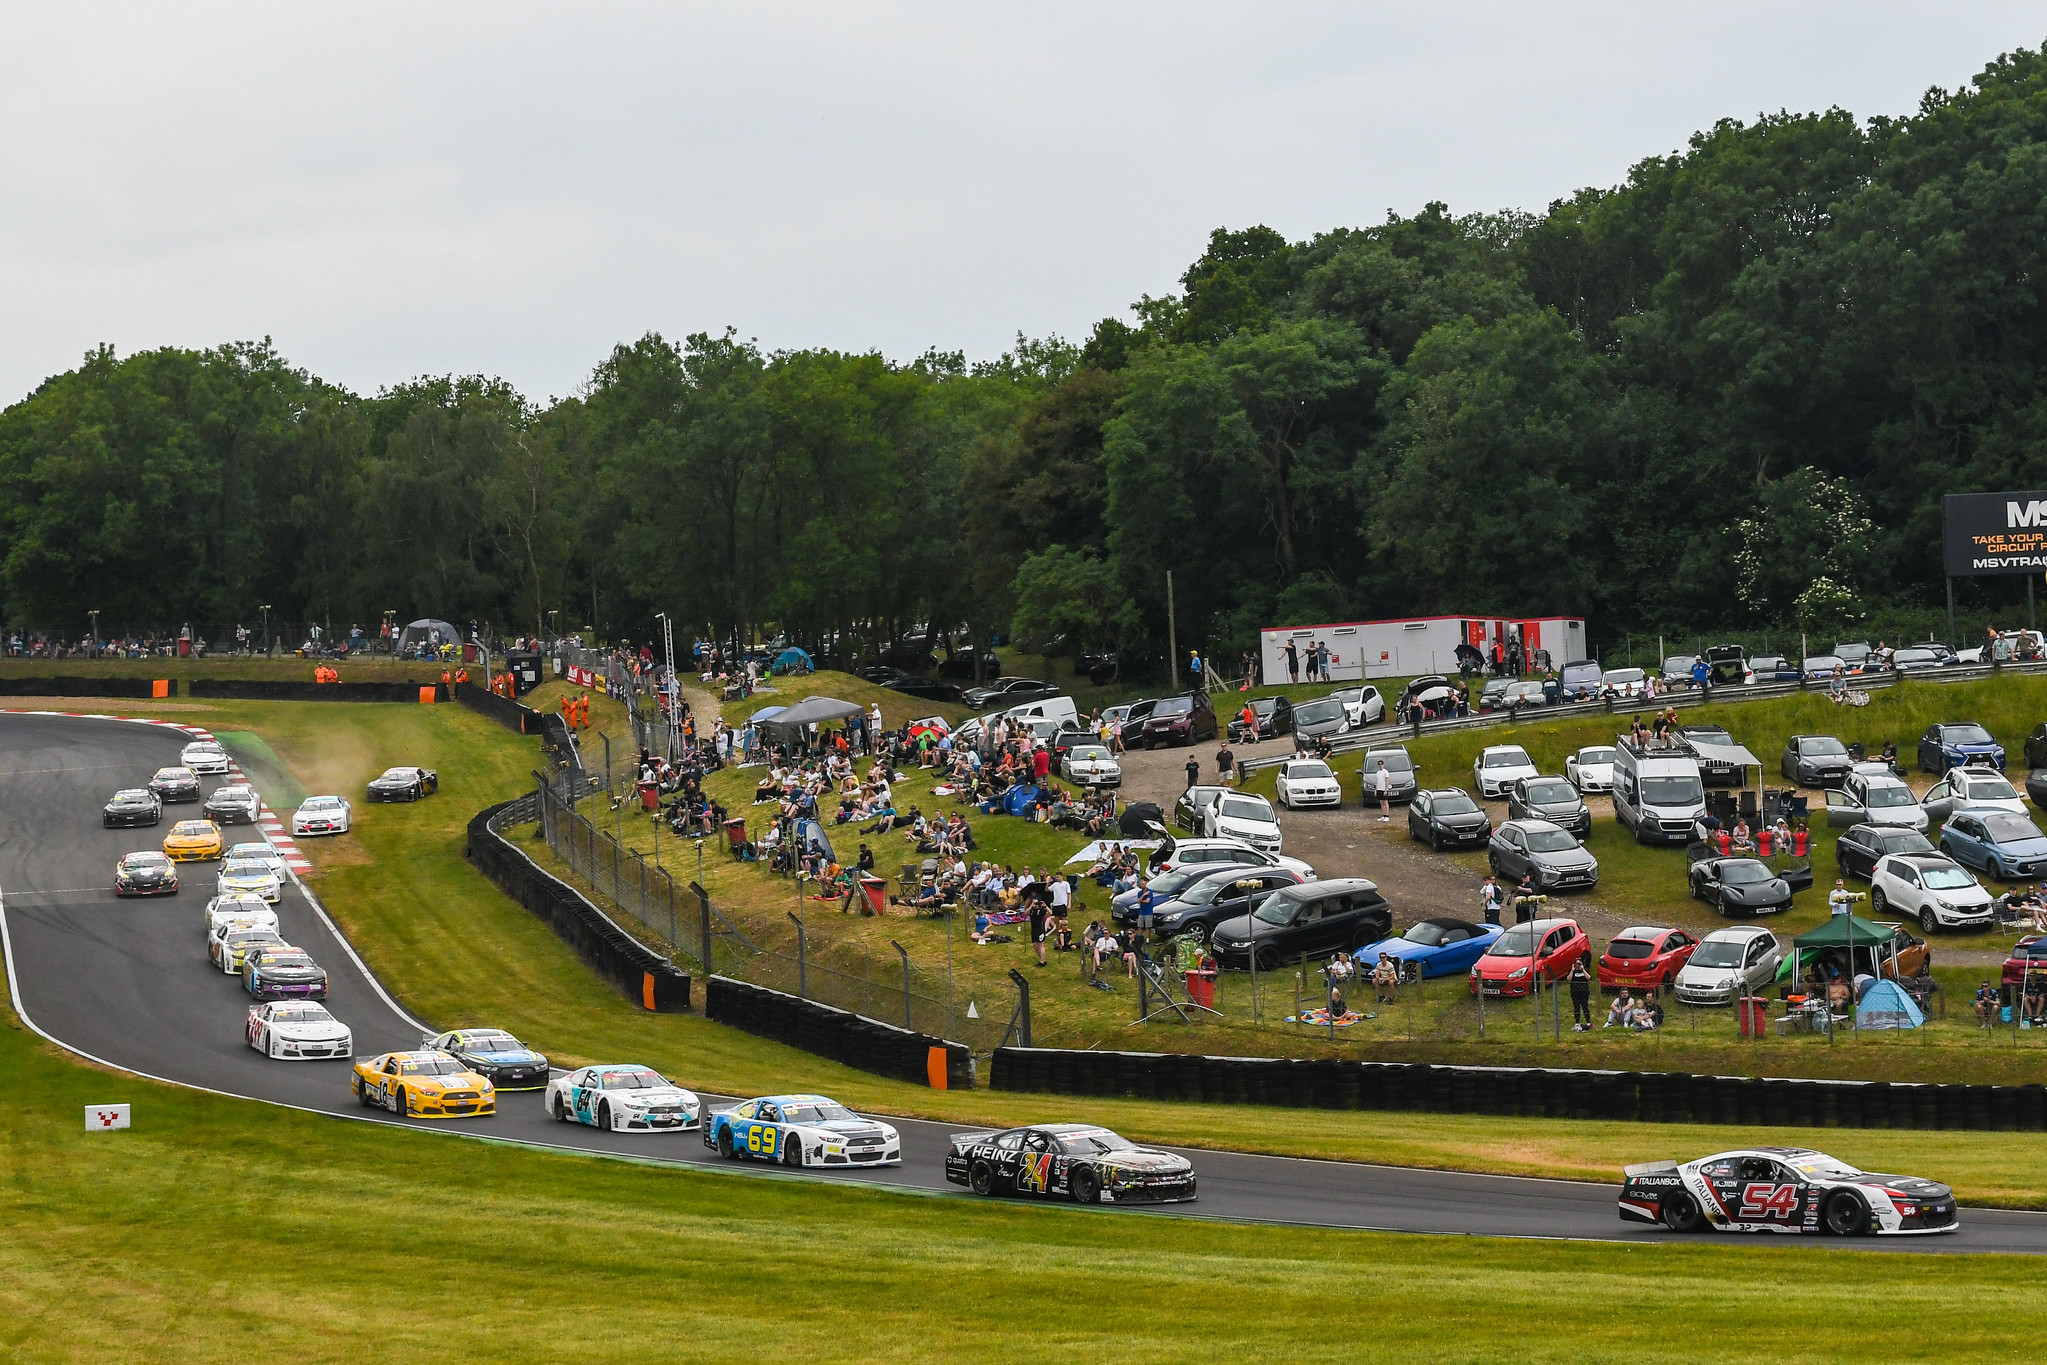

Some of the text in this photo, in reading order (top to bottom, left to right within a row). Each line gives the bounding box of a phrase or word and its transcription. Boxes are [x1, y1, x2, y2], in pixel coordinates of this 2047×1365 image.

[1972, 533, 2044, 544] TAKE YOUR
[1987, 542, 2036, 553] CIRCUIT
[379, 1080, 388, 1105] 18
[576, 1088, 593, 1113] 64
[748, 1124, 777, 1155] 69
[972, 1145, 1018, 1163] HEINZ
[1017, 1151, 1054, 1194] 24
[1638, 1177, 1682, 1186] ITALIANBOX
[1739, 1182, 1799, 1219] 54
[1903, 1206, 1916, 1215] 54
